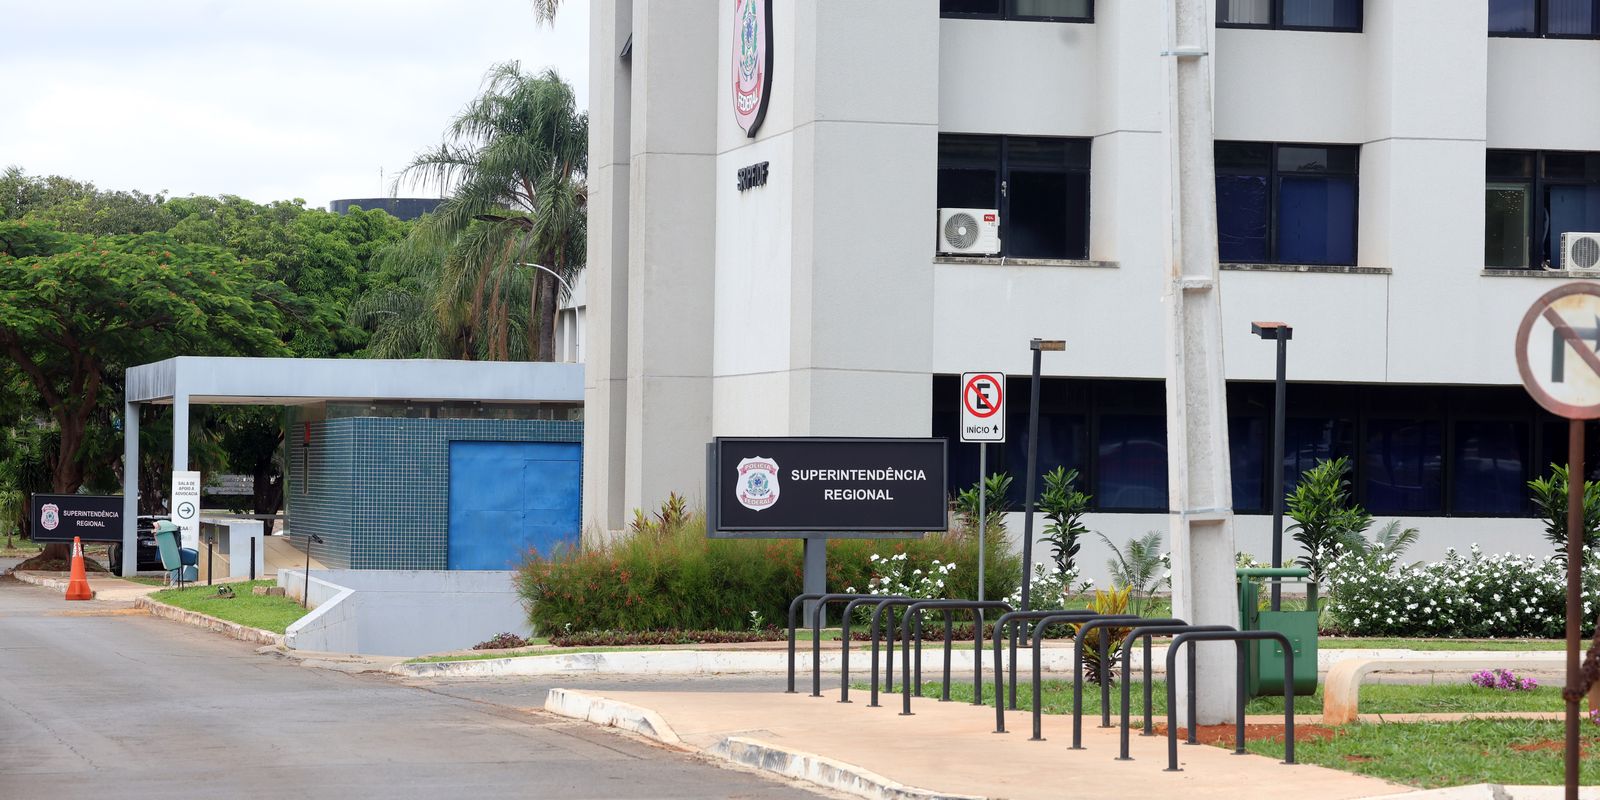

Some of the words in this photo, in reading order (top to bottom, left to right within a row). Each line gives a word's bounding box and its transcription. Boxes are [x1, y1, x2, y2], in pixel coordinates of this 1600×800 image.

[977, 383, 991, 409] E
[966, 425, 990, 434] INÍCIO
[791, 466, 927, 481] SUPERINTENDÊNCIA
[824, 489, 894, 501] REGIONAL
[63, 510, 119, 518] SUPERINTENDÊNCIA
